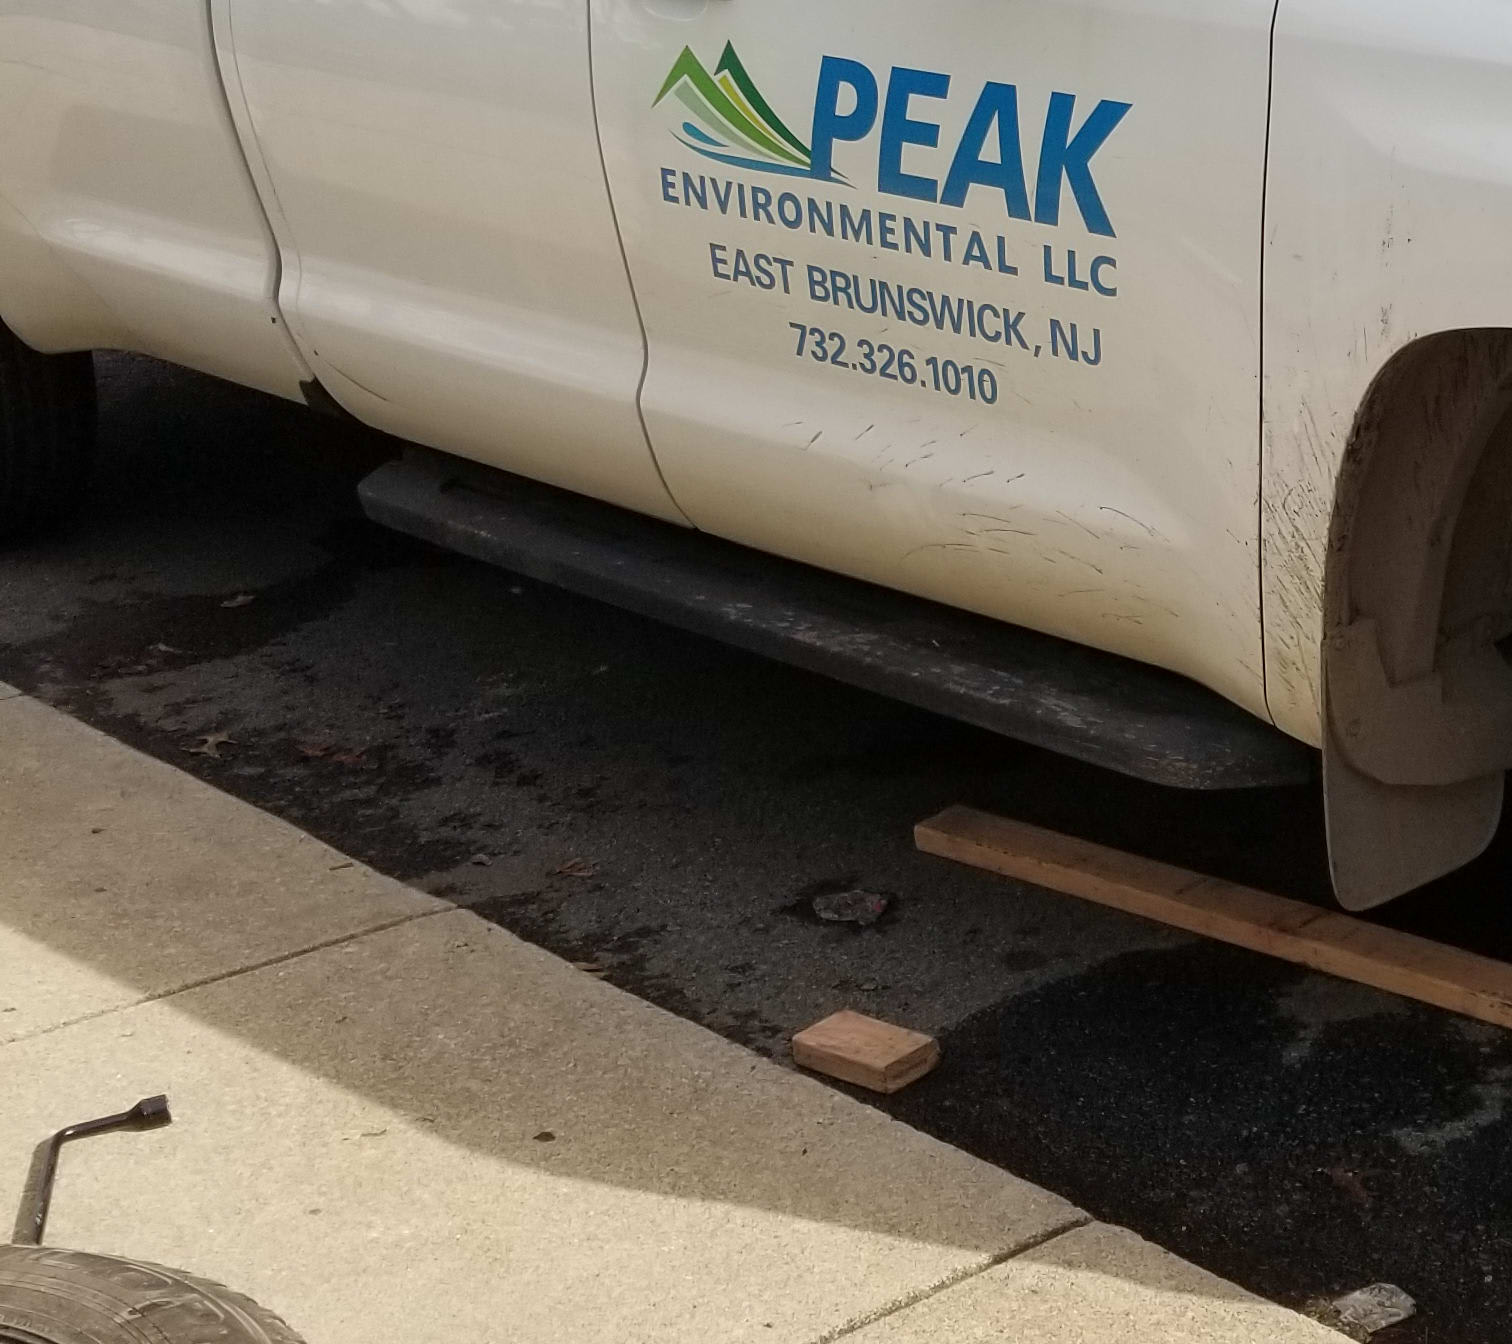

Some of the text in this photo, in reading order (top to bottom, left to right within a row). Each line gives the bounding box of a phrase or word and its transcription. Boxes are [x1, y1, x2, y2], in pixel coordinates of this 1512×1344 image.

[811, 55, 1133, 238] PEAK
[660, 167, 1117, 296] ENVIRONMENTAL LLC
[710, 242, 1101, 366] EAST BRUNSWICK, NJ
[789, 321, 998, 405] 732.326.1010
